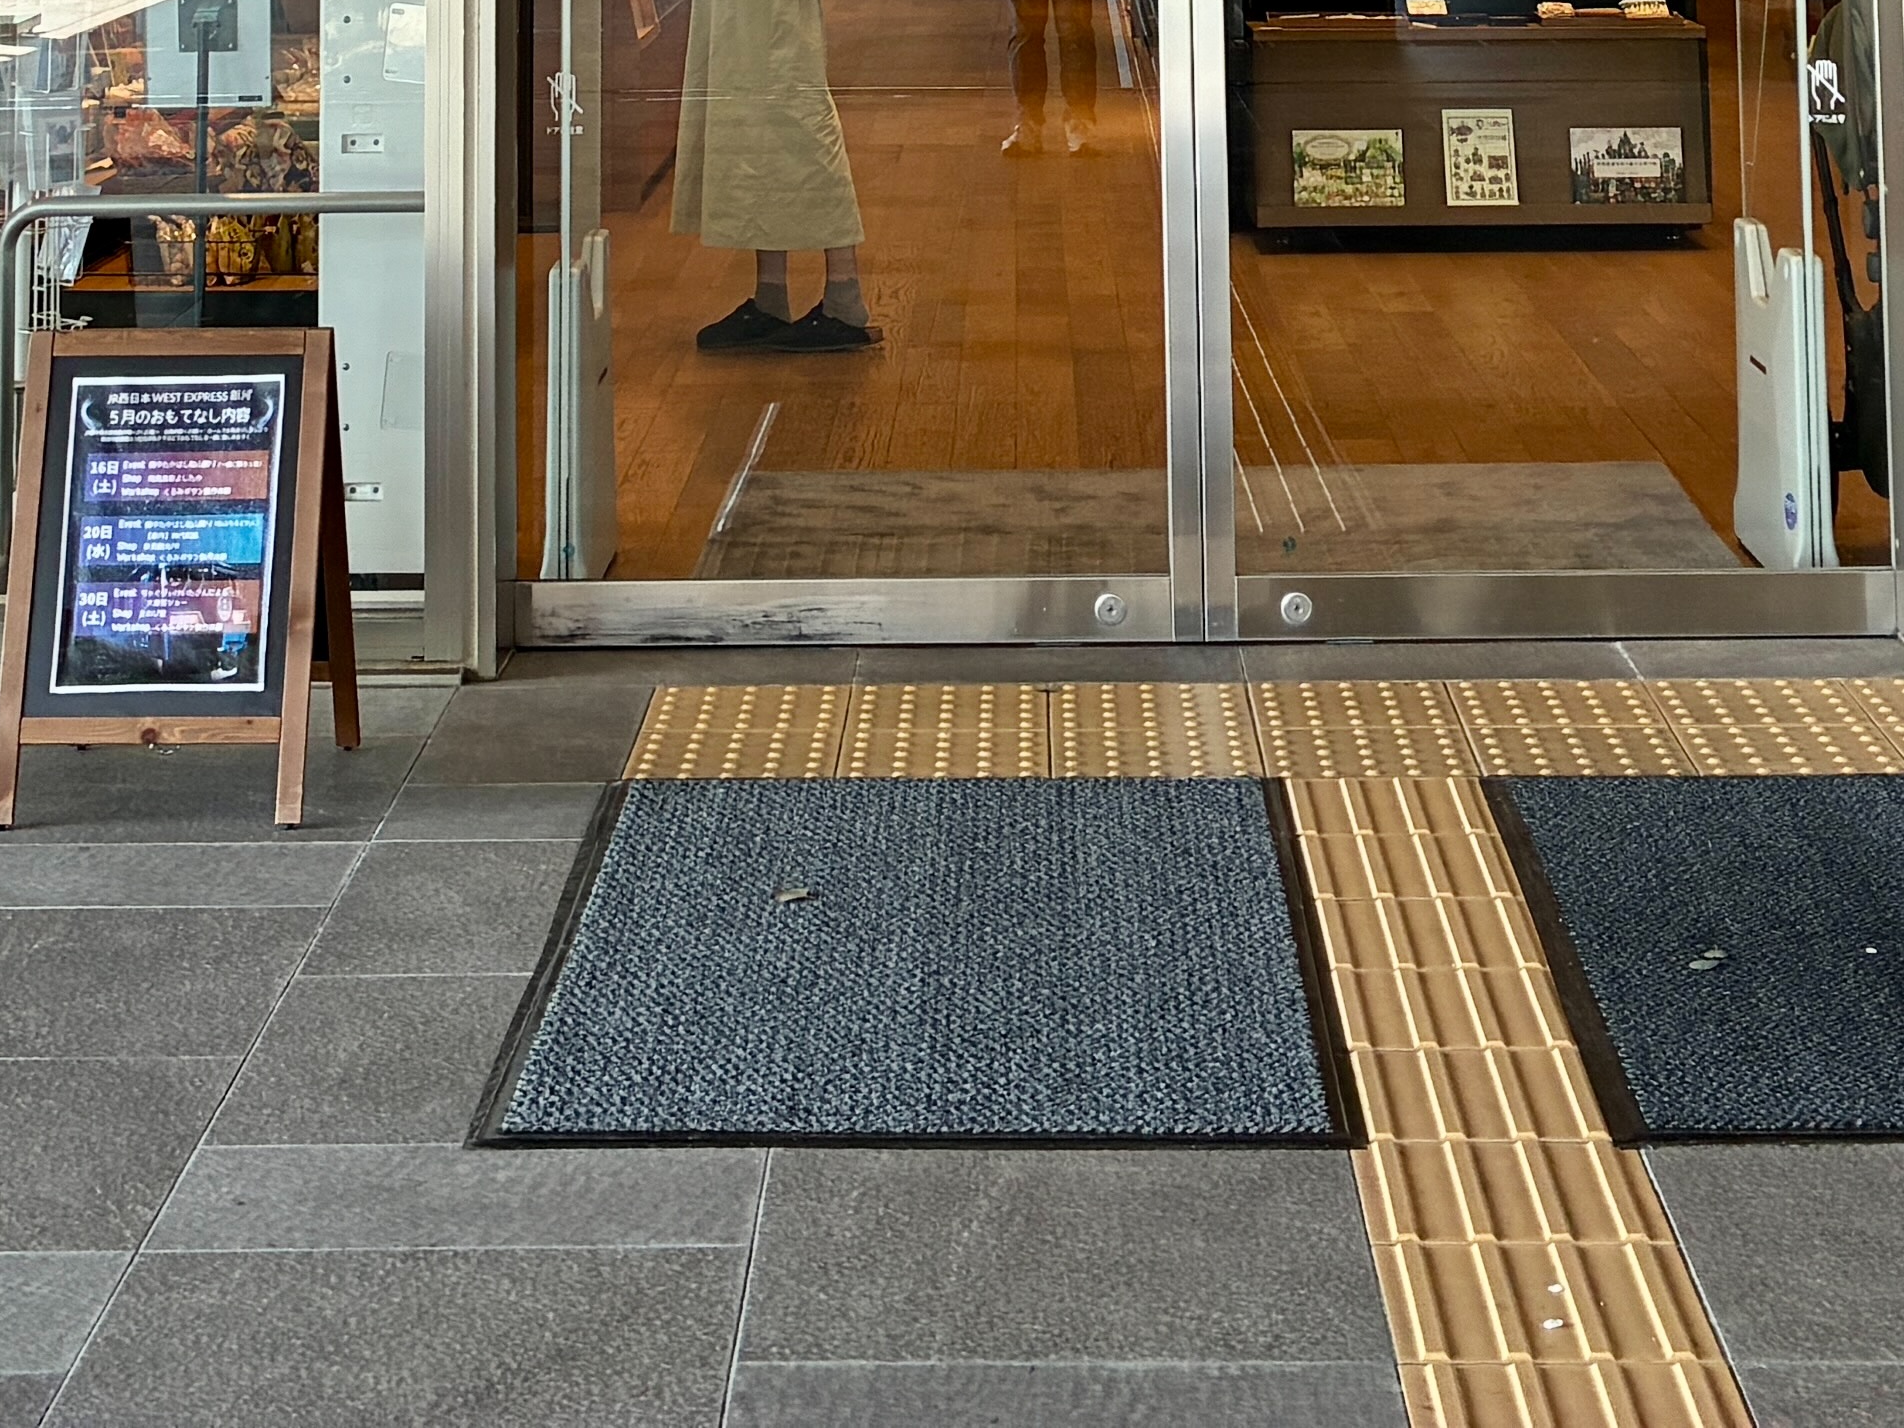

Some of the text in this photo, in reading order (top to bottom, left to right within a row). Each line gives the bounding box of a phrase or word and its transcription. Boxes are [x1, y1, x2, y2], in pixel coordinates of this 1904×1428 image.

[152, 392, 181, 403] WEST
[183, 390, 229, 403] EXPRESS
[109, 407, 252, 425] 5月のおもてなし内容
[90, 461, 119, 475] 16日
[92, 479, 117, 495] (土)
[83, 525, 112, 539] 20日
[86, 544, 110, 560] (水)
[79, 592, 108, 606] 30日
[82, 610, 106, 627] (土)
